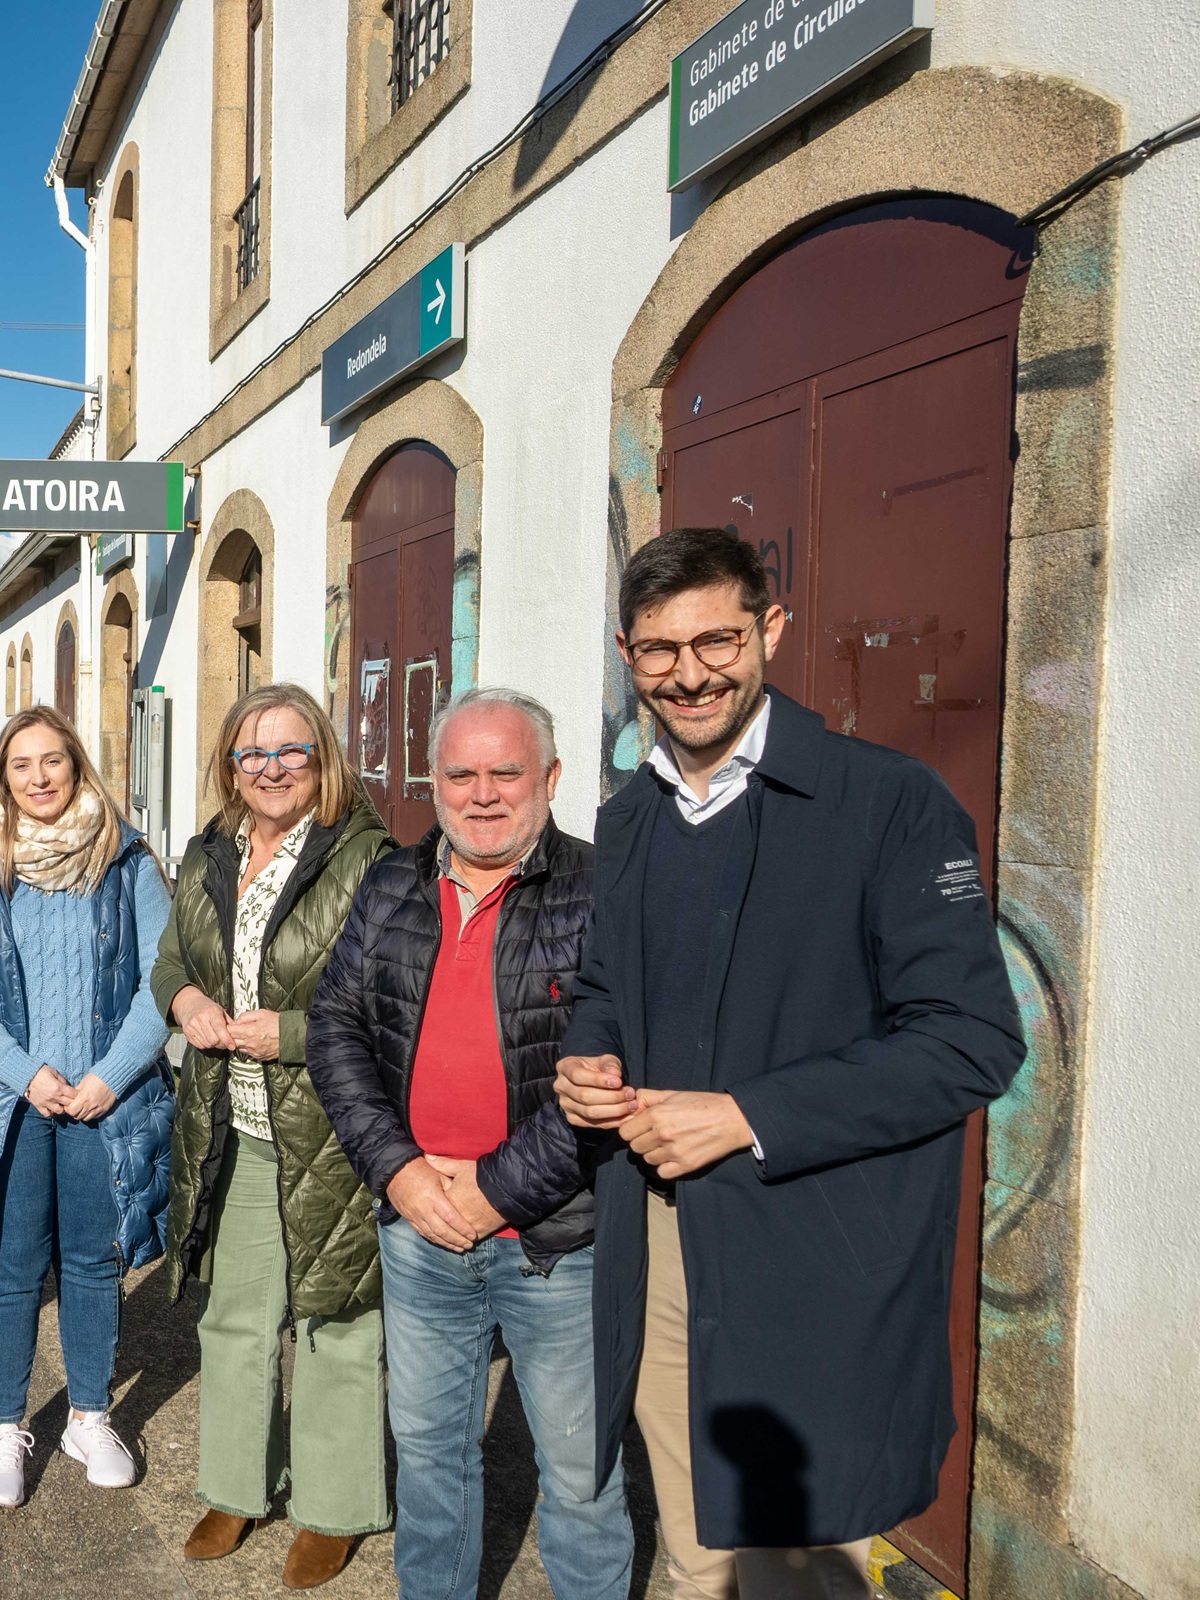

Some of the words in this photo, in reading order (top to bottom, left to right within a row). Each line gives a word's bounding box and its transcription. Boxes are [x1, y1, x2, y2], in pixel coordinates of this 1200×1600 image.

[689, 62, 758, 126] Gabinete
[765, 40, 786, 71] de
[793, 0, 865, 50] Circula
[690, 23, 757, 87] Gabinete
[764, 0, 783, 29] de
[347, 333, 386, 379] Redondela
